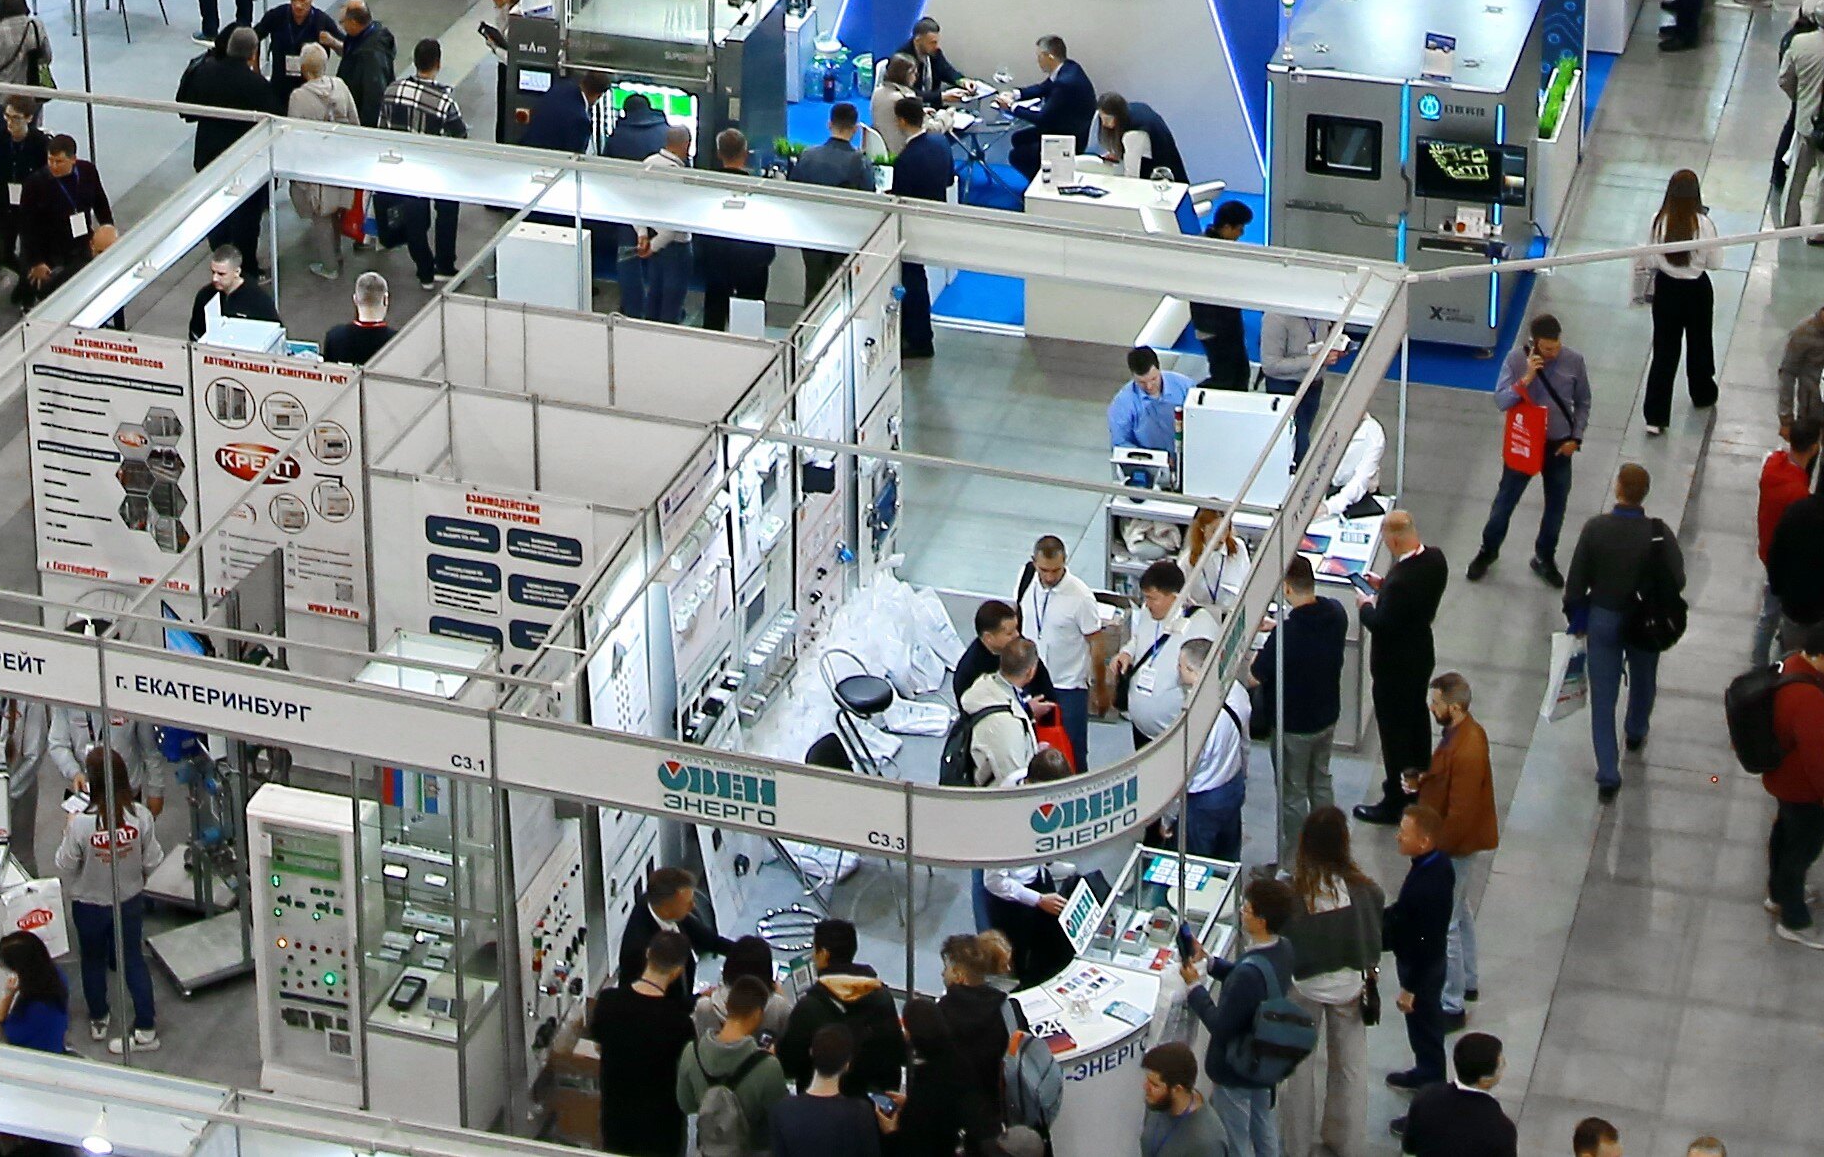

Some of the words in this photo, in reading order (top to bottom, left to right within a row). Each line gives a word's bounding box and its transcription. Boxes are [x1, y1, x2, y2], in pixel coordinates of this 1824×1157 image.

[74, 337, 138, 354] АВТОМАТИЗАЦИЯ
[119, 355, 164, 370] ПРОЦЕССОВ
[203, 355, 270, 375] АВТОМАТИЗАЦИЯ
[276, 364, 323, 382] ИЗМЕРЕНИЯ
[465, 493, 541, 514] ВЗАИМОДЕЙСТВИЕ
[474, 507, 541, 526] ИНТЕГРАТОРАМИ
[114, 675, 130, 691] г.
[134, 678, 313, 724] ЕКАТЕРИНБУРГ
[450, 753, 486, 774] C3.1
[657, 759, 776, 808] ОВЕН
[663, 792, 776, 827] ЭНЕРГО
[1029, 775, 1139, 835] ОВЕН
[868, 830, 906, 852] C3.3
[1034, 807, 1138, 853] ЭНЕРГО
[1074, 905, 1103, 950] ЭНЕРГО
